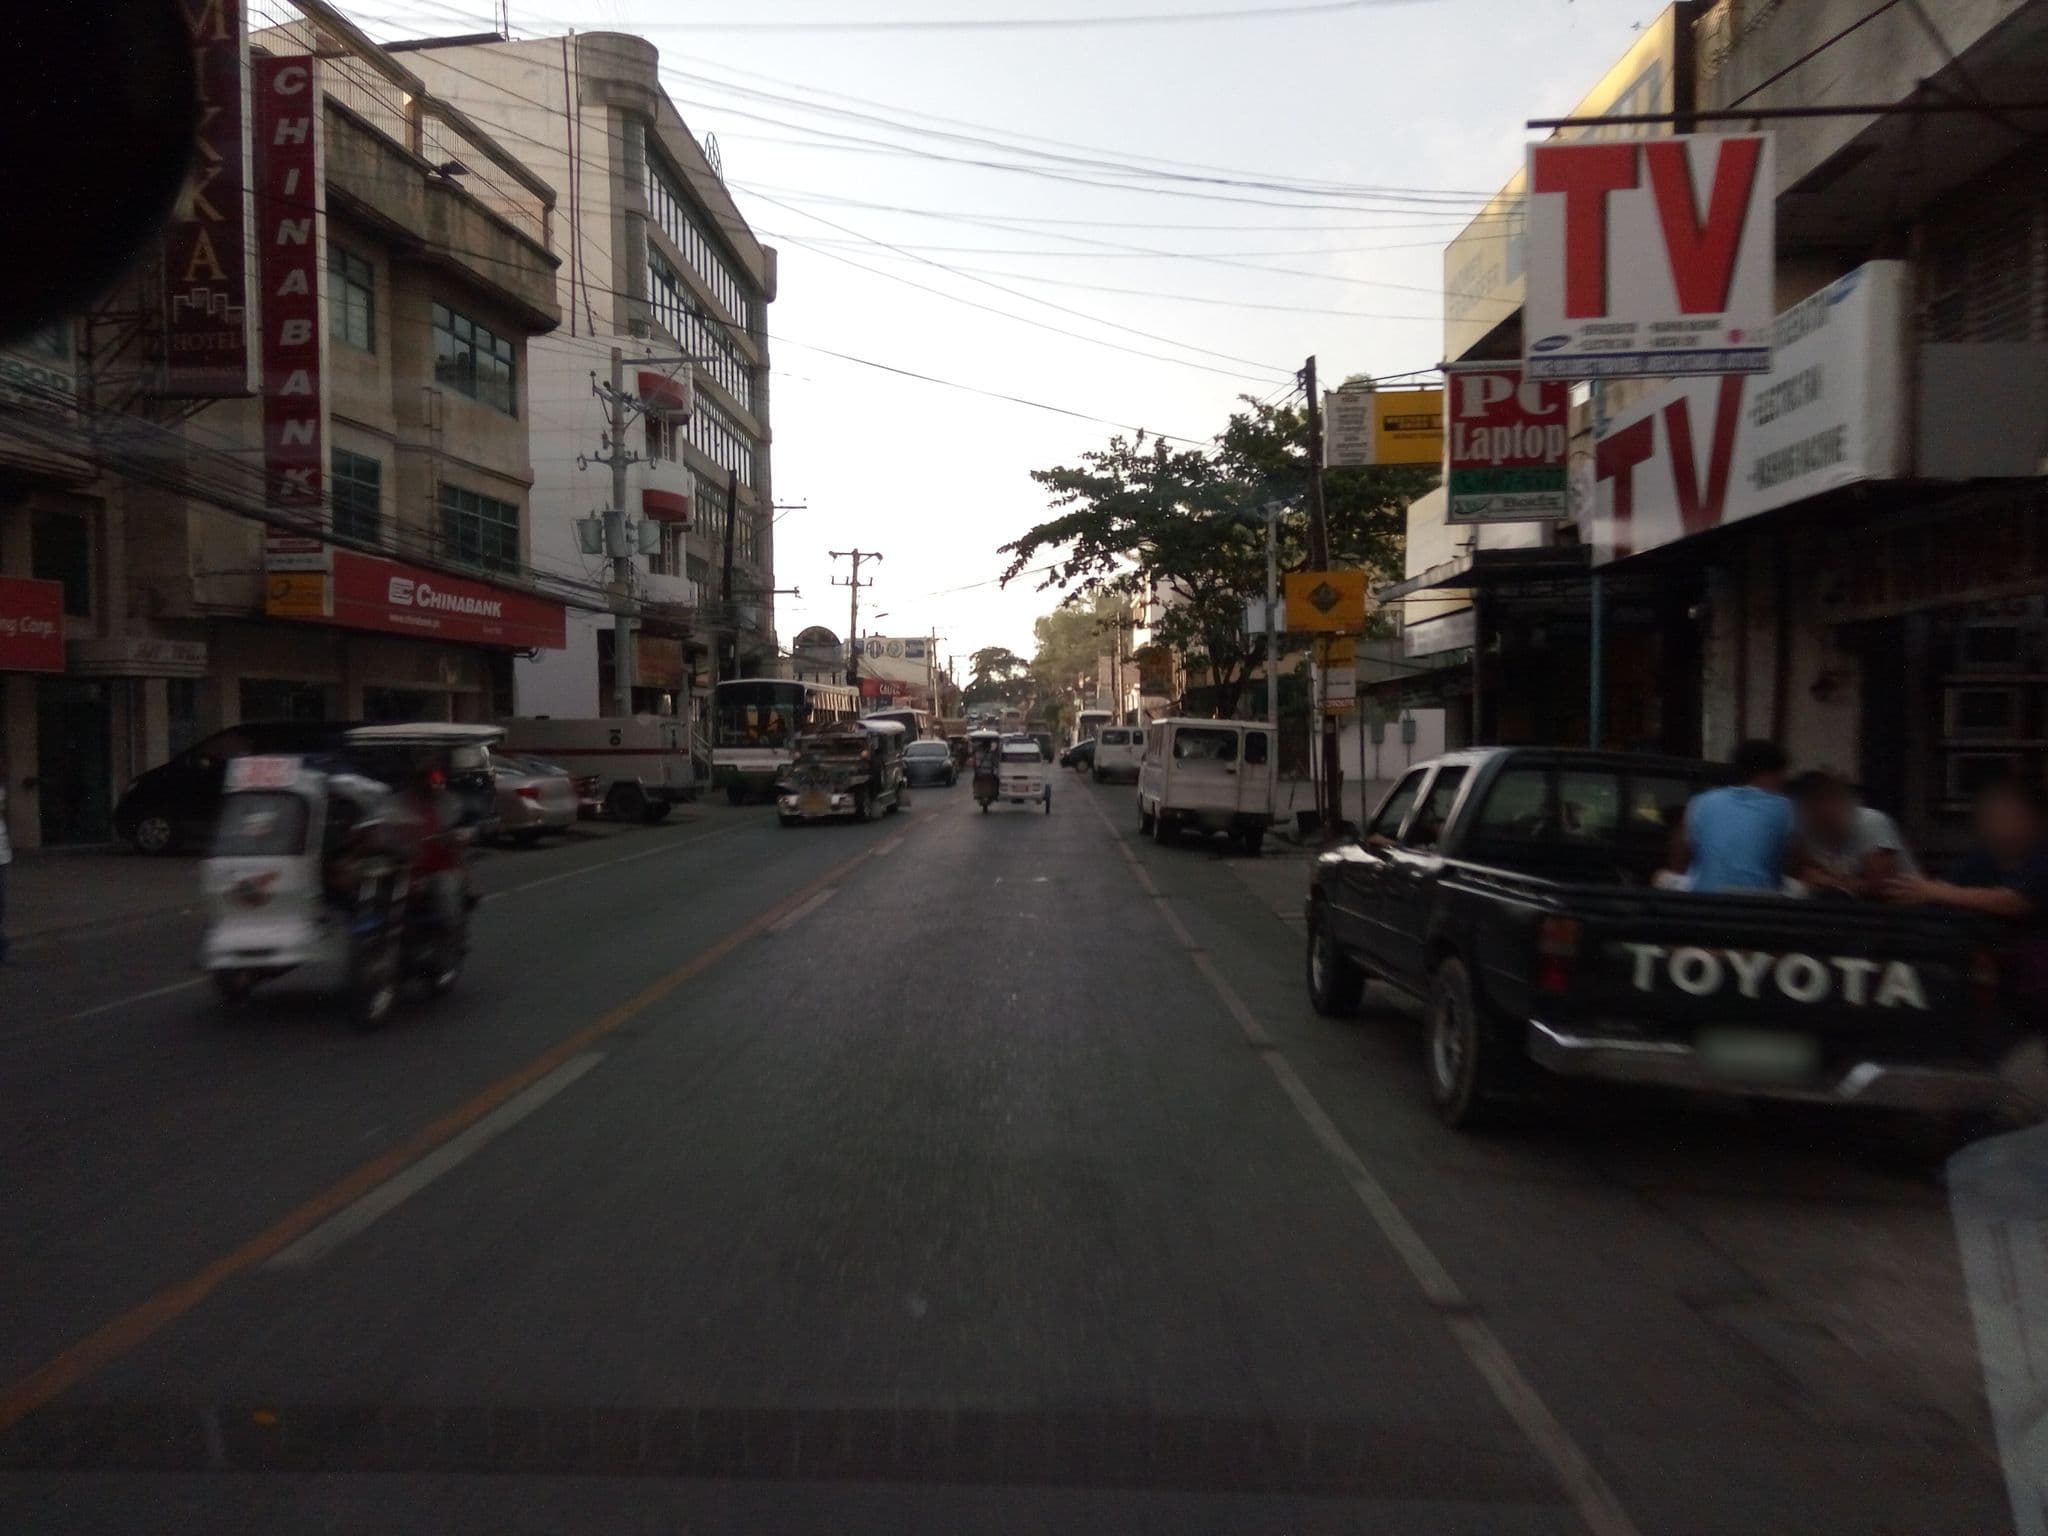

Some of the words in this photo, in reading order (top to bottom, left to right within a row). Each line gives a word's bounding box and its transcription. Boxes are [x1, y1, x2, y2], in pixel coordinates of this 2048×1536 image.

[272, 66, 315, 497] CHINABANK
[1534, 138, 1763, 319] TV
[1452, 421, 1566, 465] Laptop
[1458, 376, 1560, 418] PC
[1596, 374, 1744, 559] TV
[1620, 942, 1932, 1011] TOYOTA
